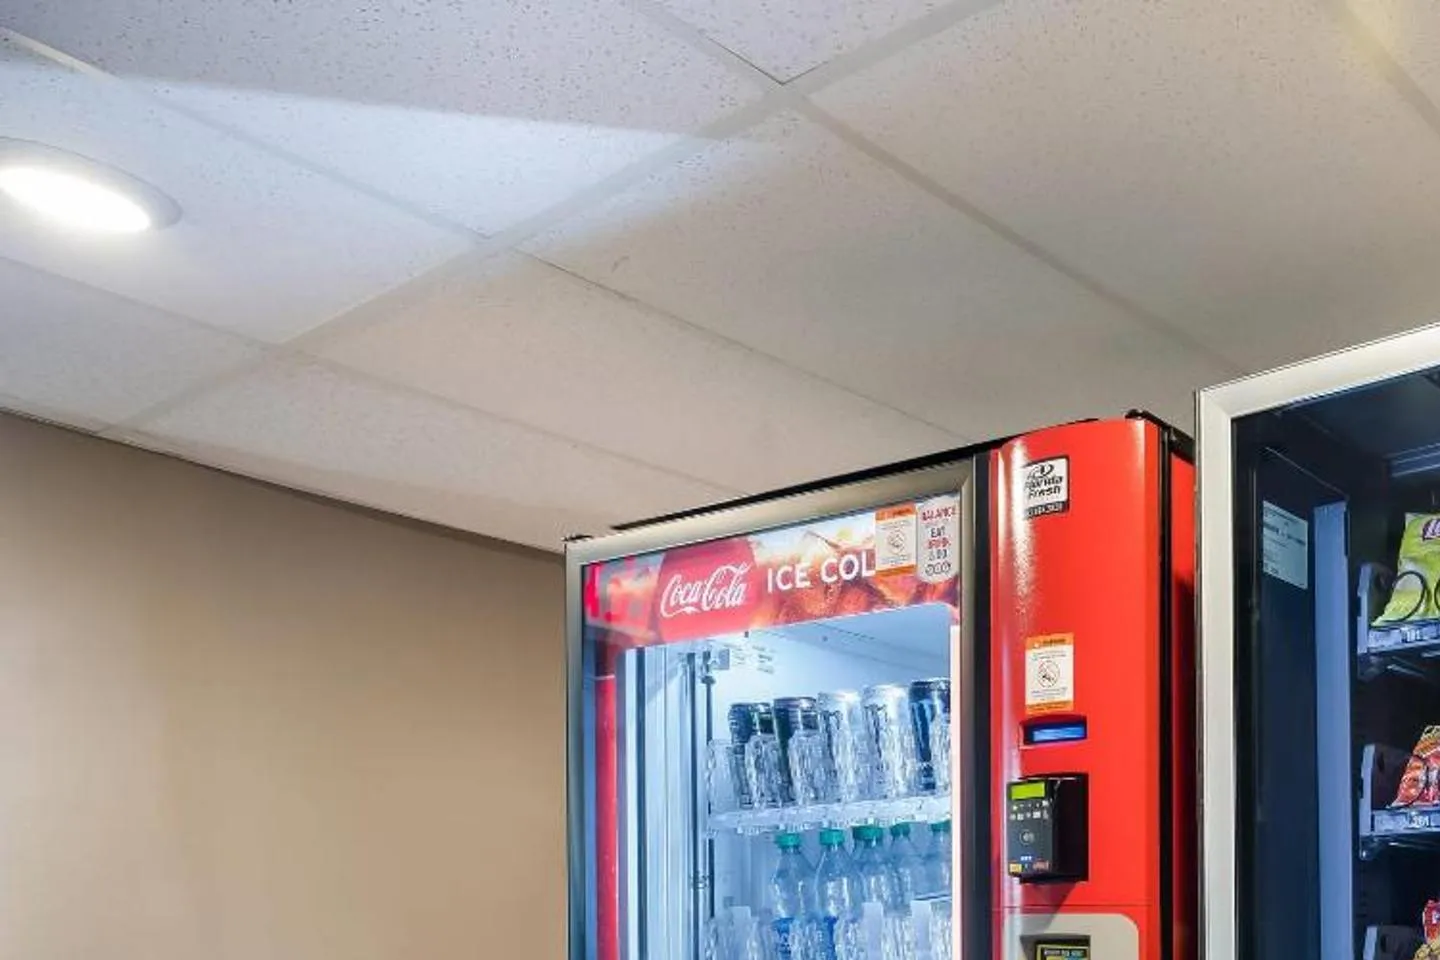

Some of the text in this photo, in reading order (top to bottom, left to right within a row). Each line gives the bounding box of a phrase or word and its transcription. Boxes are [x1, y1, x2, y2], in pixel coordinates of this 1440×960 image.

[660, 561, 750, 618] Coca-Cola
[767, 548, 876, 593] ICE COL
